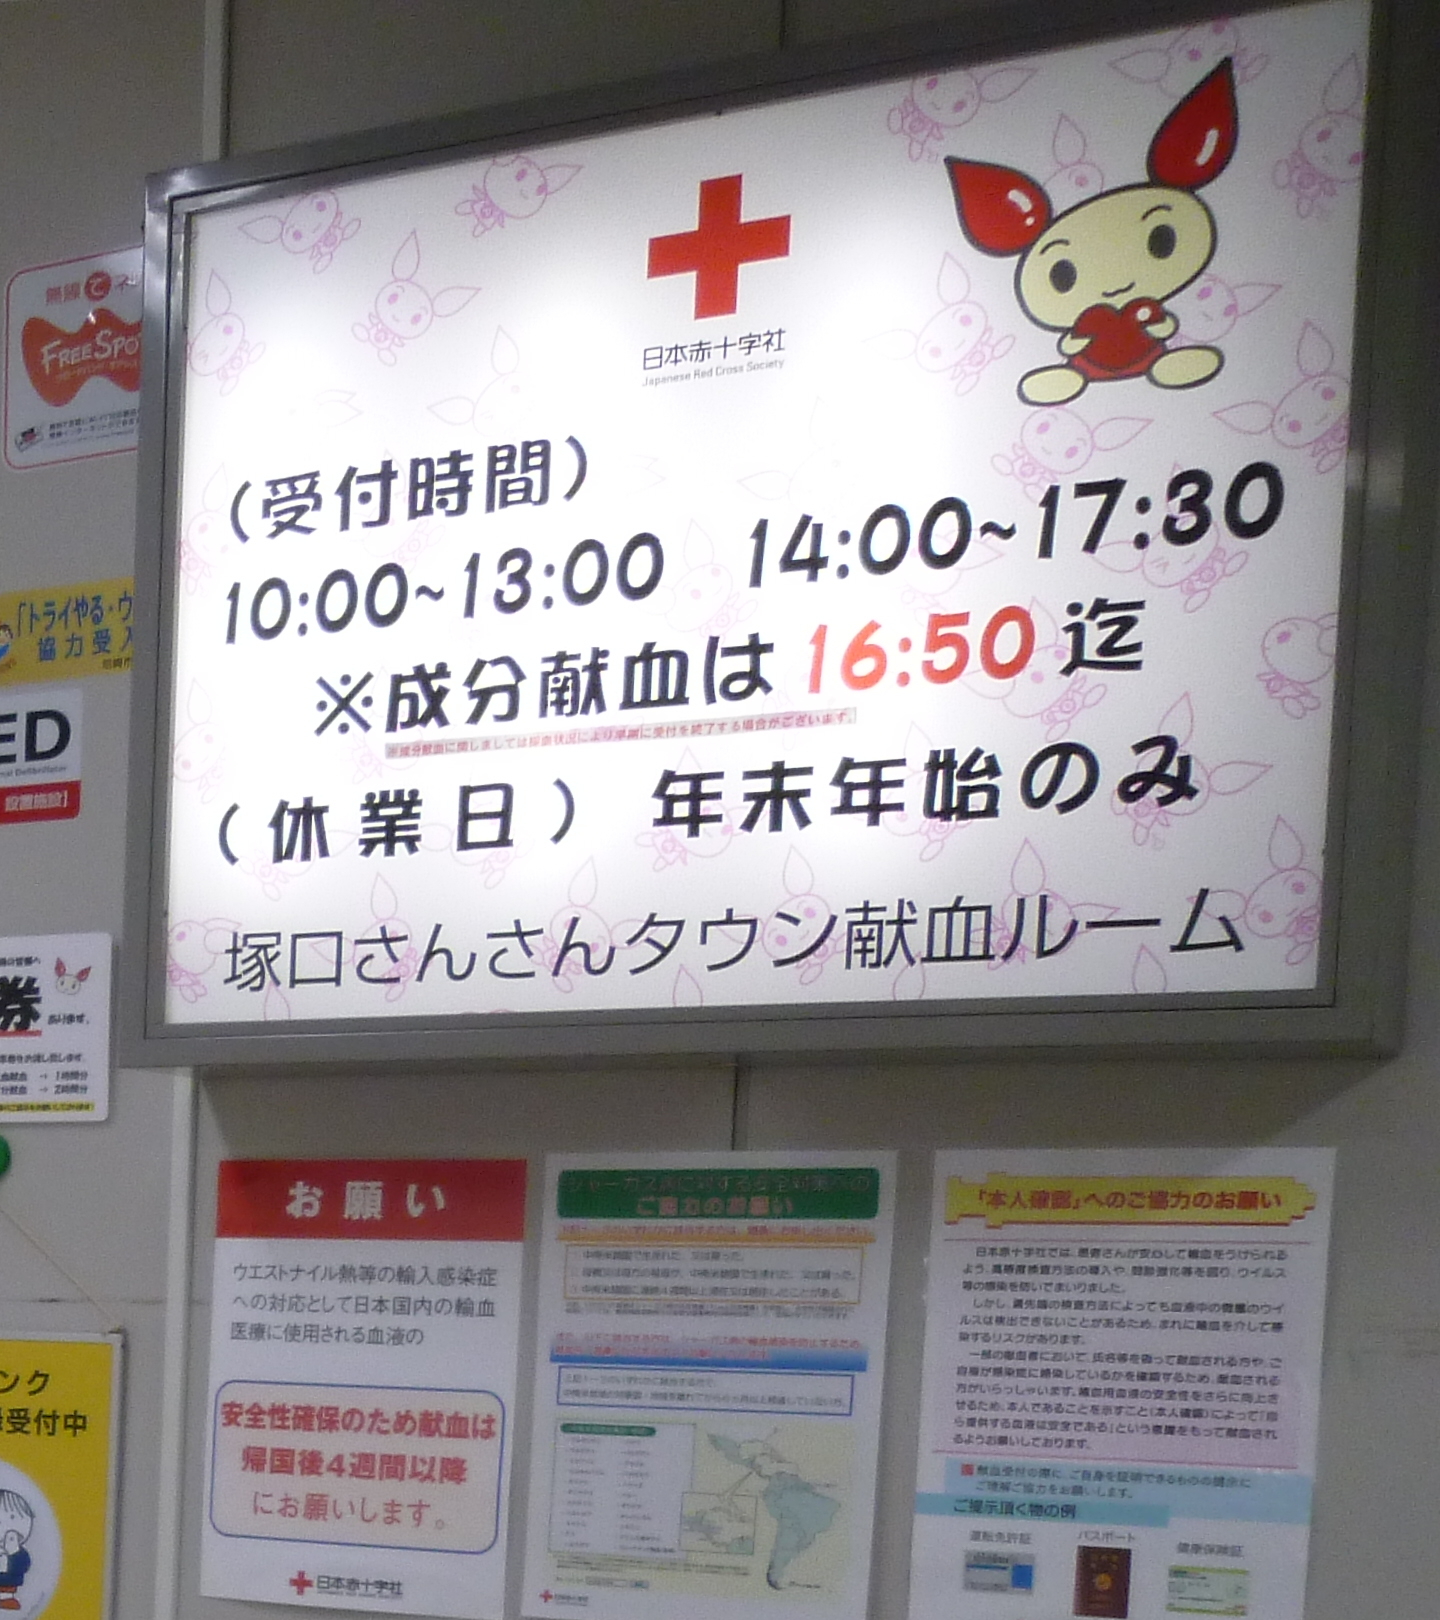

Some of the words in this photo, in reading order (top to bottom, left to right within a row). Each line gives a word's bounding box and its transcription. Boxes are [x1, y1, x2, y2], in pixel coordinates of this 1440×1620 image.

[643, 328, 786, 370] 日本赤十字社
[642, 371, 691, 387] Japanese
[693, 367, 713, 380] Red
[715, 363, 744, 378] Cross
[746, 359, 785, 373] Society
[808, 604, 1035, 695] 16:50
[1060, 599, 1145, 677] 迄
[652, 733, 1197, 840] 年末年始のみ
[224, 888, 1244, 992] 塚口さんさんタウン献血ルーム
[285, 1181, 445, 1220] お願い
[233, 1262, 497, 1288] ウエストナイル熱等の輸入感染症
[232, 1293, 496, 1318] への対応として日本国内の輸血
[230, 1322, 424, 1347] 医療に使用される血液の
[222, 1401, 497, 1441] 安全性確保のため献血は
[242, 1446, 468, 1486] 帰国後4週間以降
[252, 1490, 447, 1532] にお願いします。
[316, 1575, 404, 1595] 日本赤十字社
